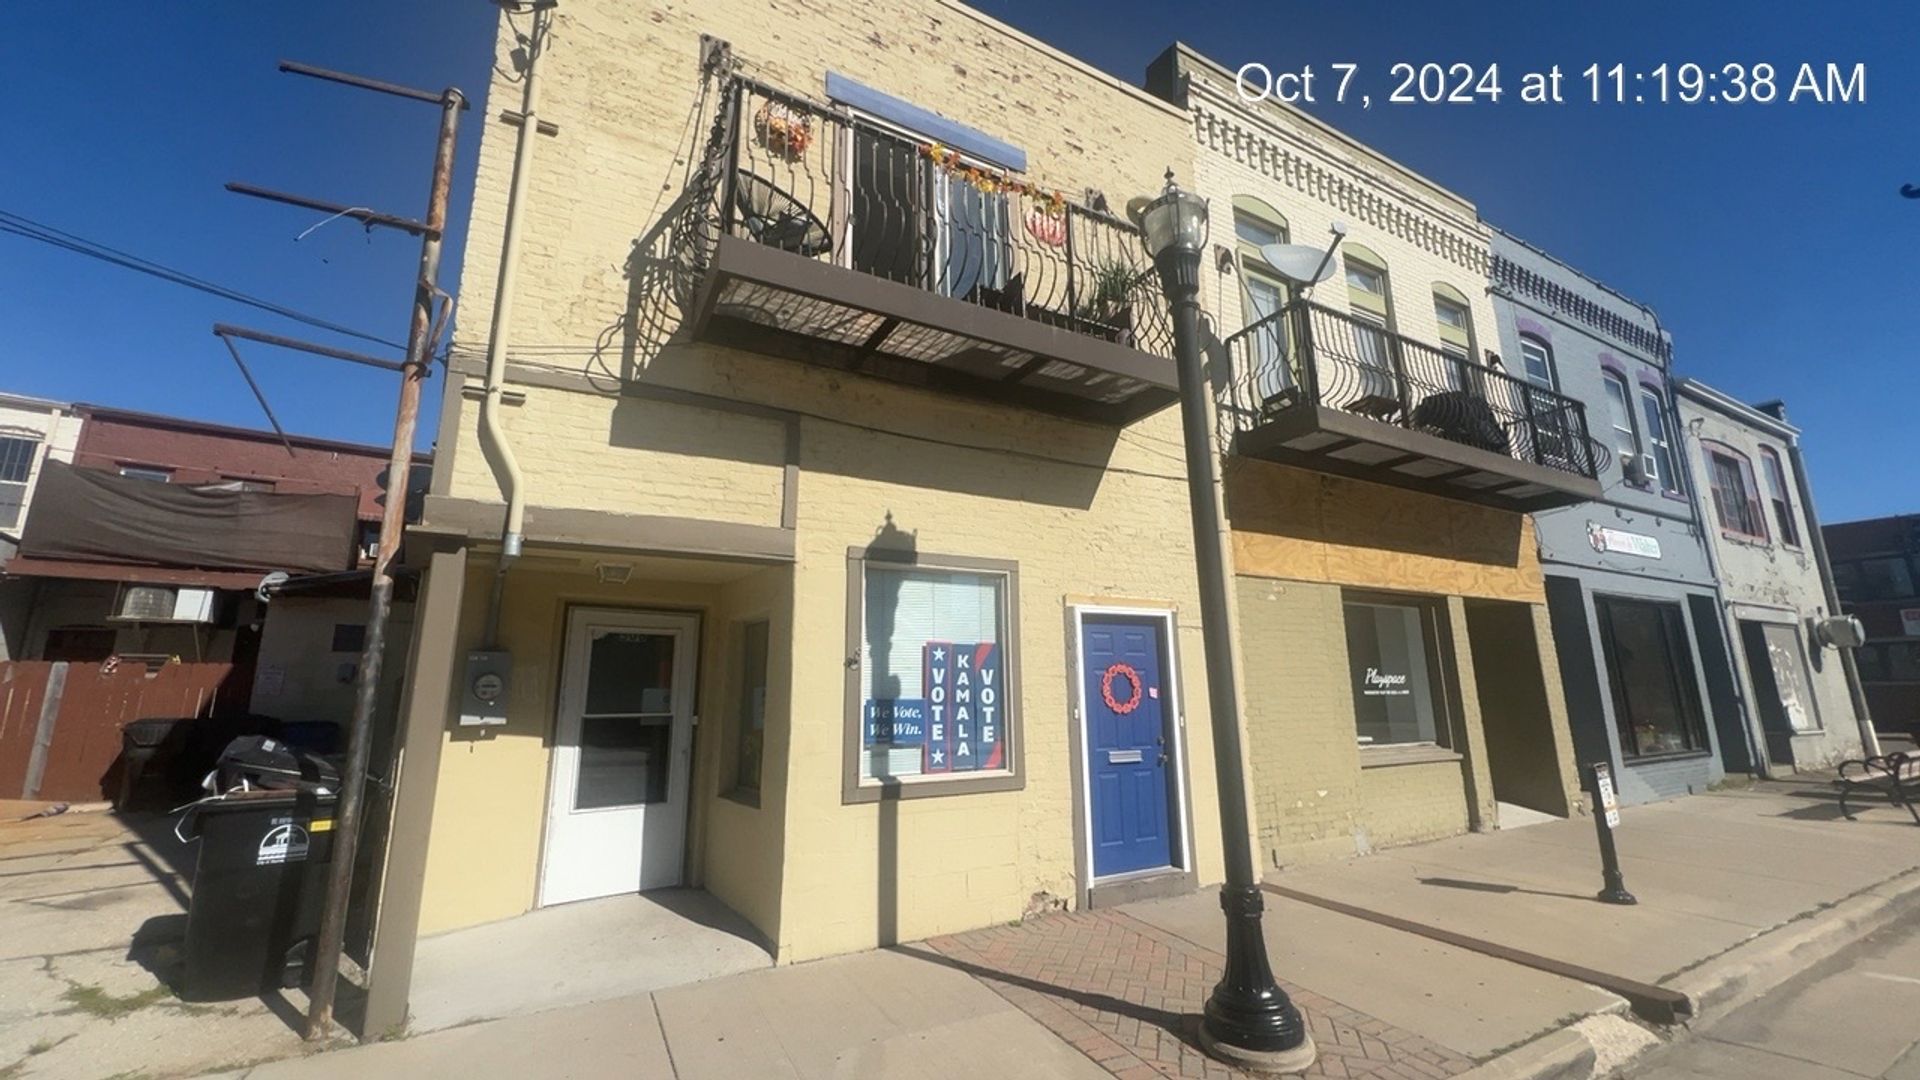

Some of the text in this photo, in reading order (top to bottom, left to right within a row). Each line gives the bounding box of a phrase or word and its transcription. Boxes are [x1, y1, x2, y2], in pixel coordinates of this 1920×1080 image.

[870, 707, 889, 719] We
[870, 722, 922, 736] We Win.
[931, 668, 945, 741] VOTE
[956, 654, 970, 756] KAMALA
[981, 669, 995, 743] VOTE
